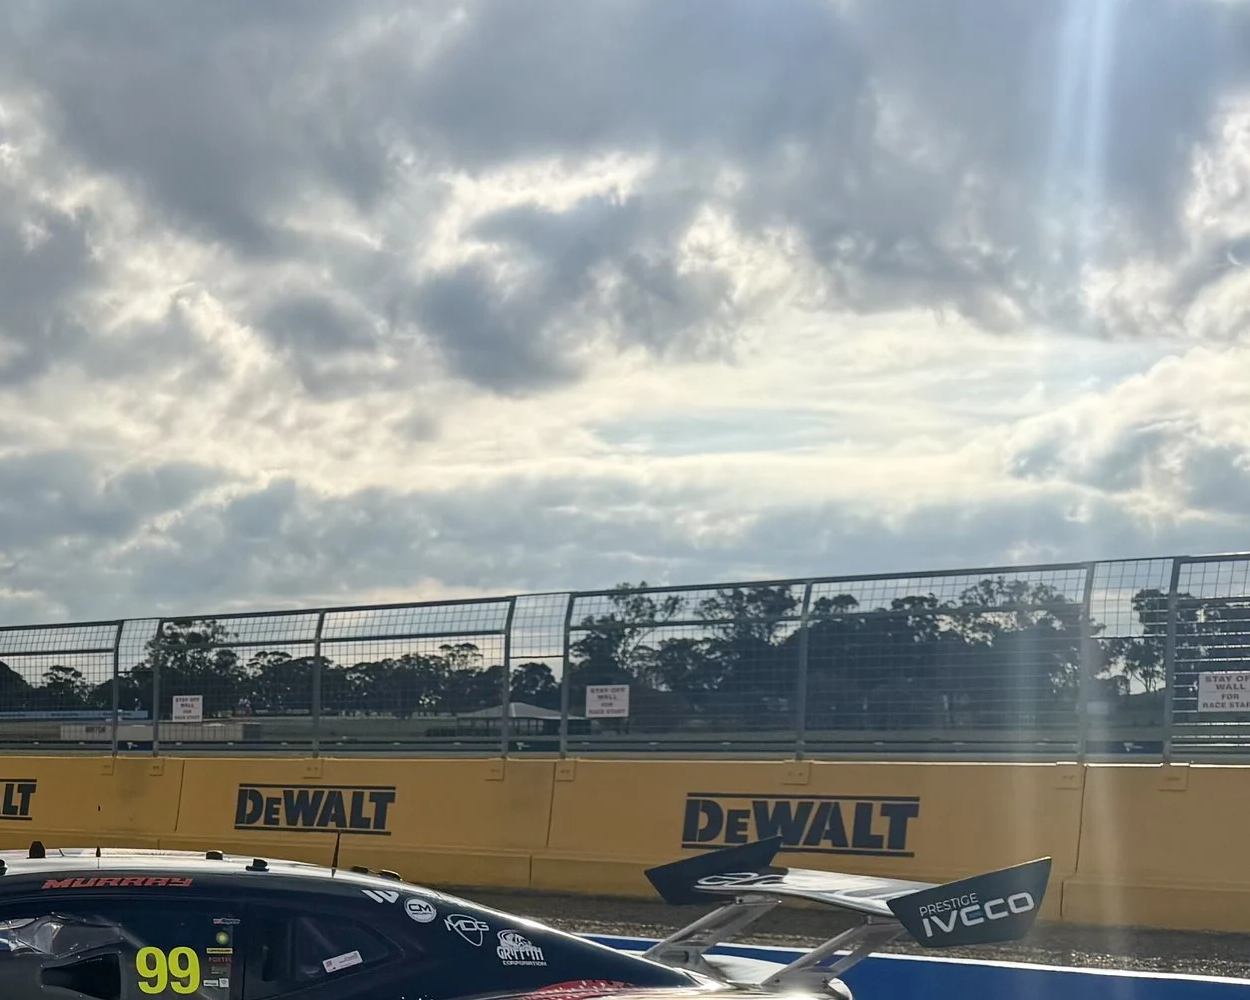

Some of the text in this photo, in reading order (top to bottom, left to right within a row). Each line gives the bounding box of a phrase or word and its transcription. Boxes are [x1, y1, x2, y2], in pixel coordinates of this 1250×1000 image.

[235, 788, 395, 830] DeWALT
[682, 799, 919, 851] DeWALT
[41, 876, 194, 889] MURRAY
[410, 903, 432, 913] CM
[919, 892, 980, 917] PRESTIGE
[921, 892, 1035, 938] IVECO
[496, 944, 544, 961] GRIFFITH
[136, 946, 201, 994] 99
